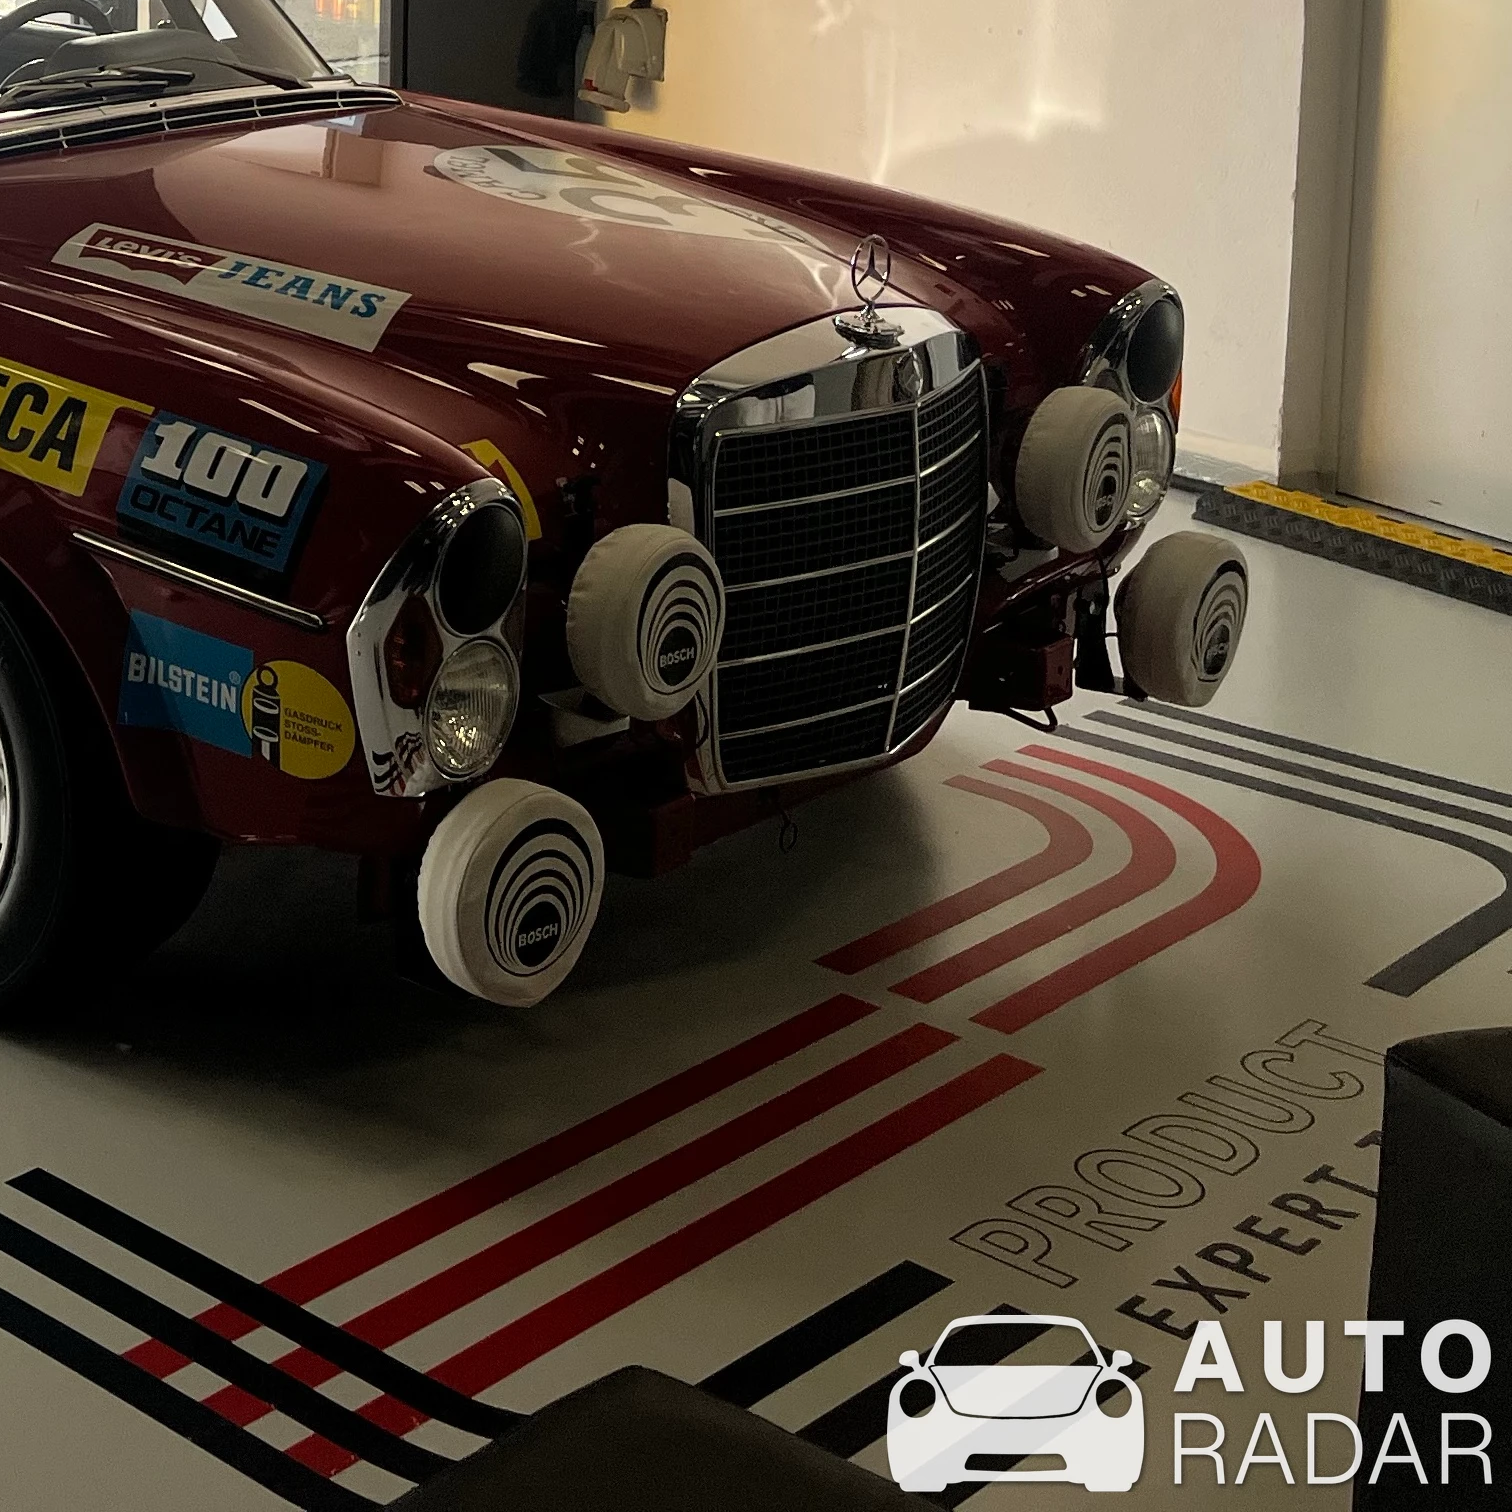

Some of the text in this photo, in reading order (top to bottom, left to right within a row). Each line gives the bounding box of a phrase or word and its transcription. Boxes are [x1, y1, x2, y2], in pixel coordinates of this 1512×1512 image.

[446, 155, 546, 201] CAMEL
[217, 260, 386, 319] JEANS
[140, 420, 309, 518] 100
[129, 483, 284, 560] OCTANE
[127, 651, 237, 714] BILSTEIN
[659, 646, 695, 668] BOSCH
[283, 707, 344, 733] GASDRUCK
[518, 922, 559, 948] BOSCH
[948, 1018, 1388, 1289] PRODUCT
[1115, 1162, 1379, 1341] EXPERT
